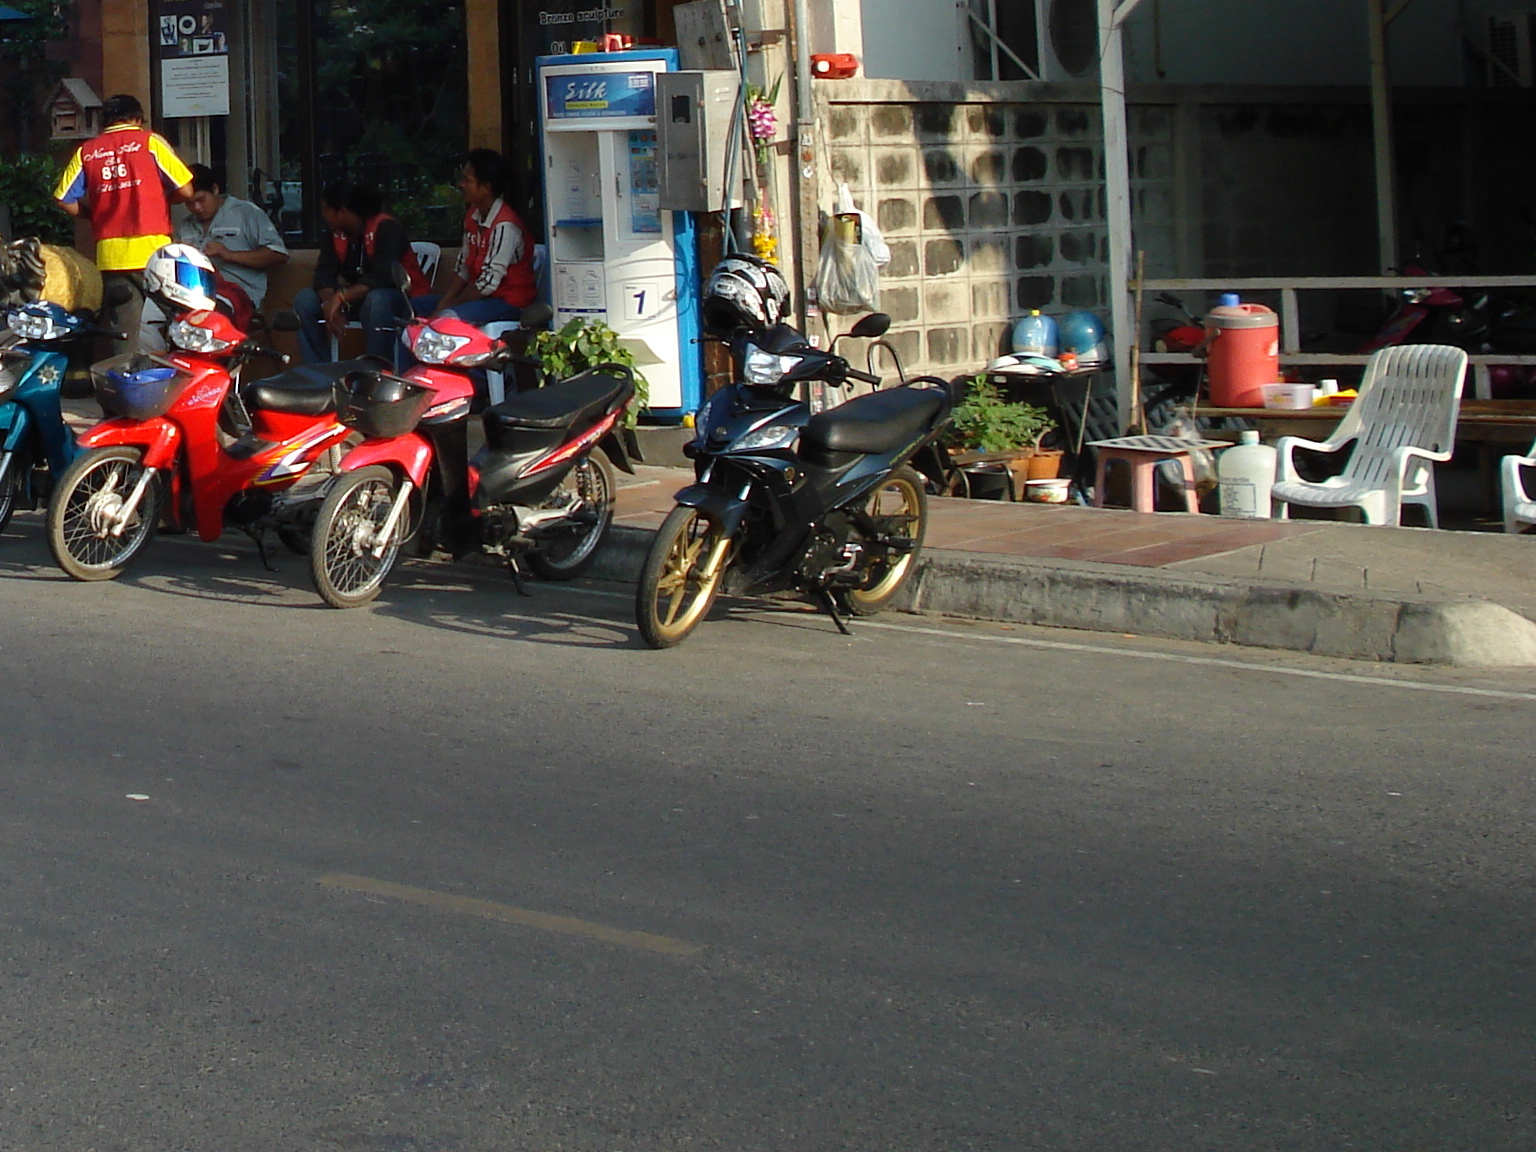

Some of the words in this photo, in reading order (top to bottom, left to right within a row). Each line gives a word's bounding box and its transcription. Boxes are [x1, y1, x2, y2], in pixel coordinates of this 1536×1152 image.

[539, 11, 575, 25] Bronze
[577, 7, 625, 22] sculpture
[565, 81, 607, 101] Silk
[633, 289, 646, 315] 1
